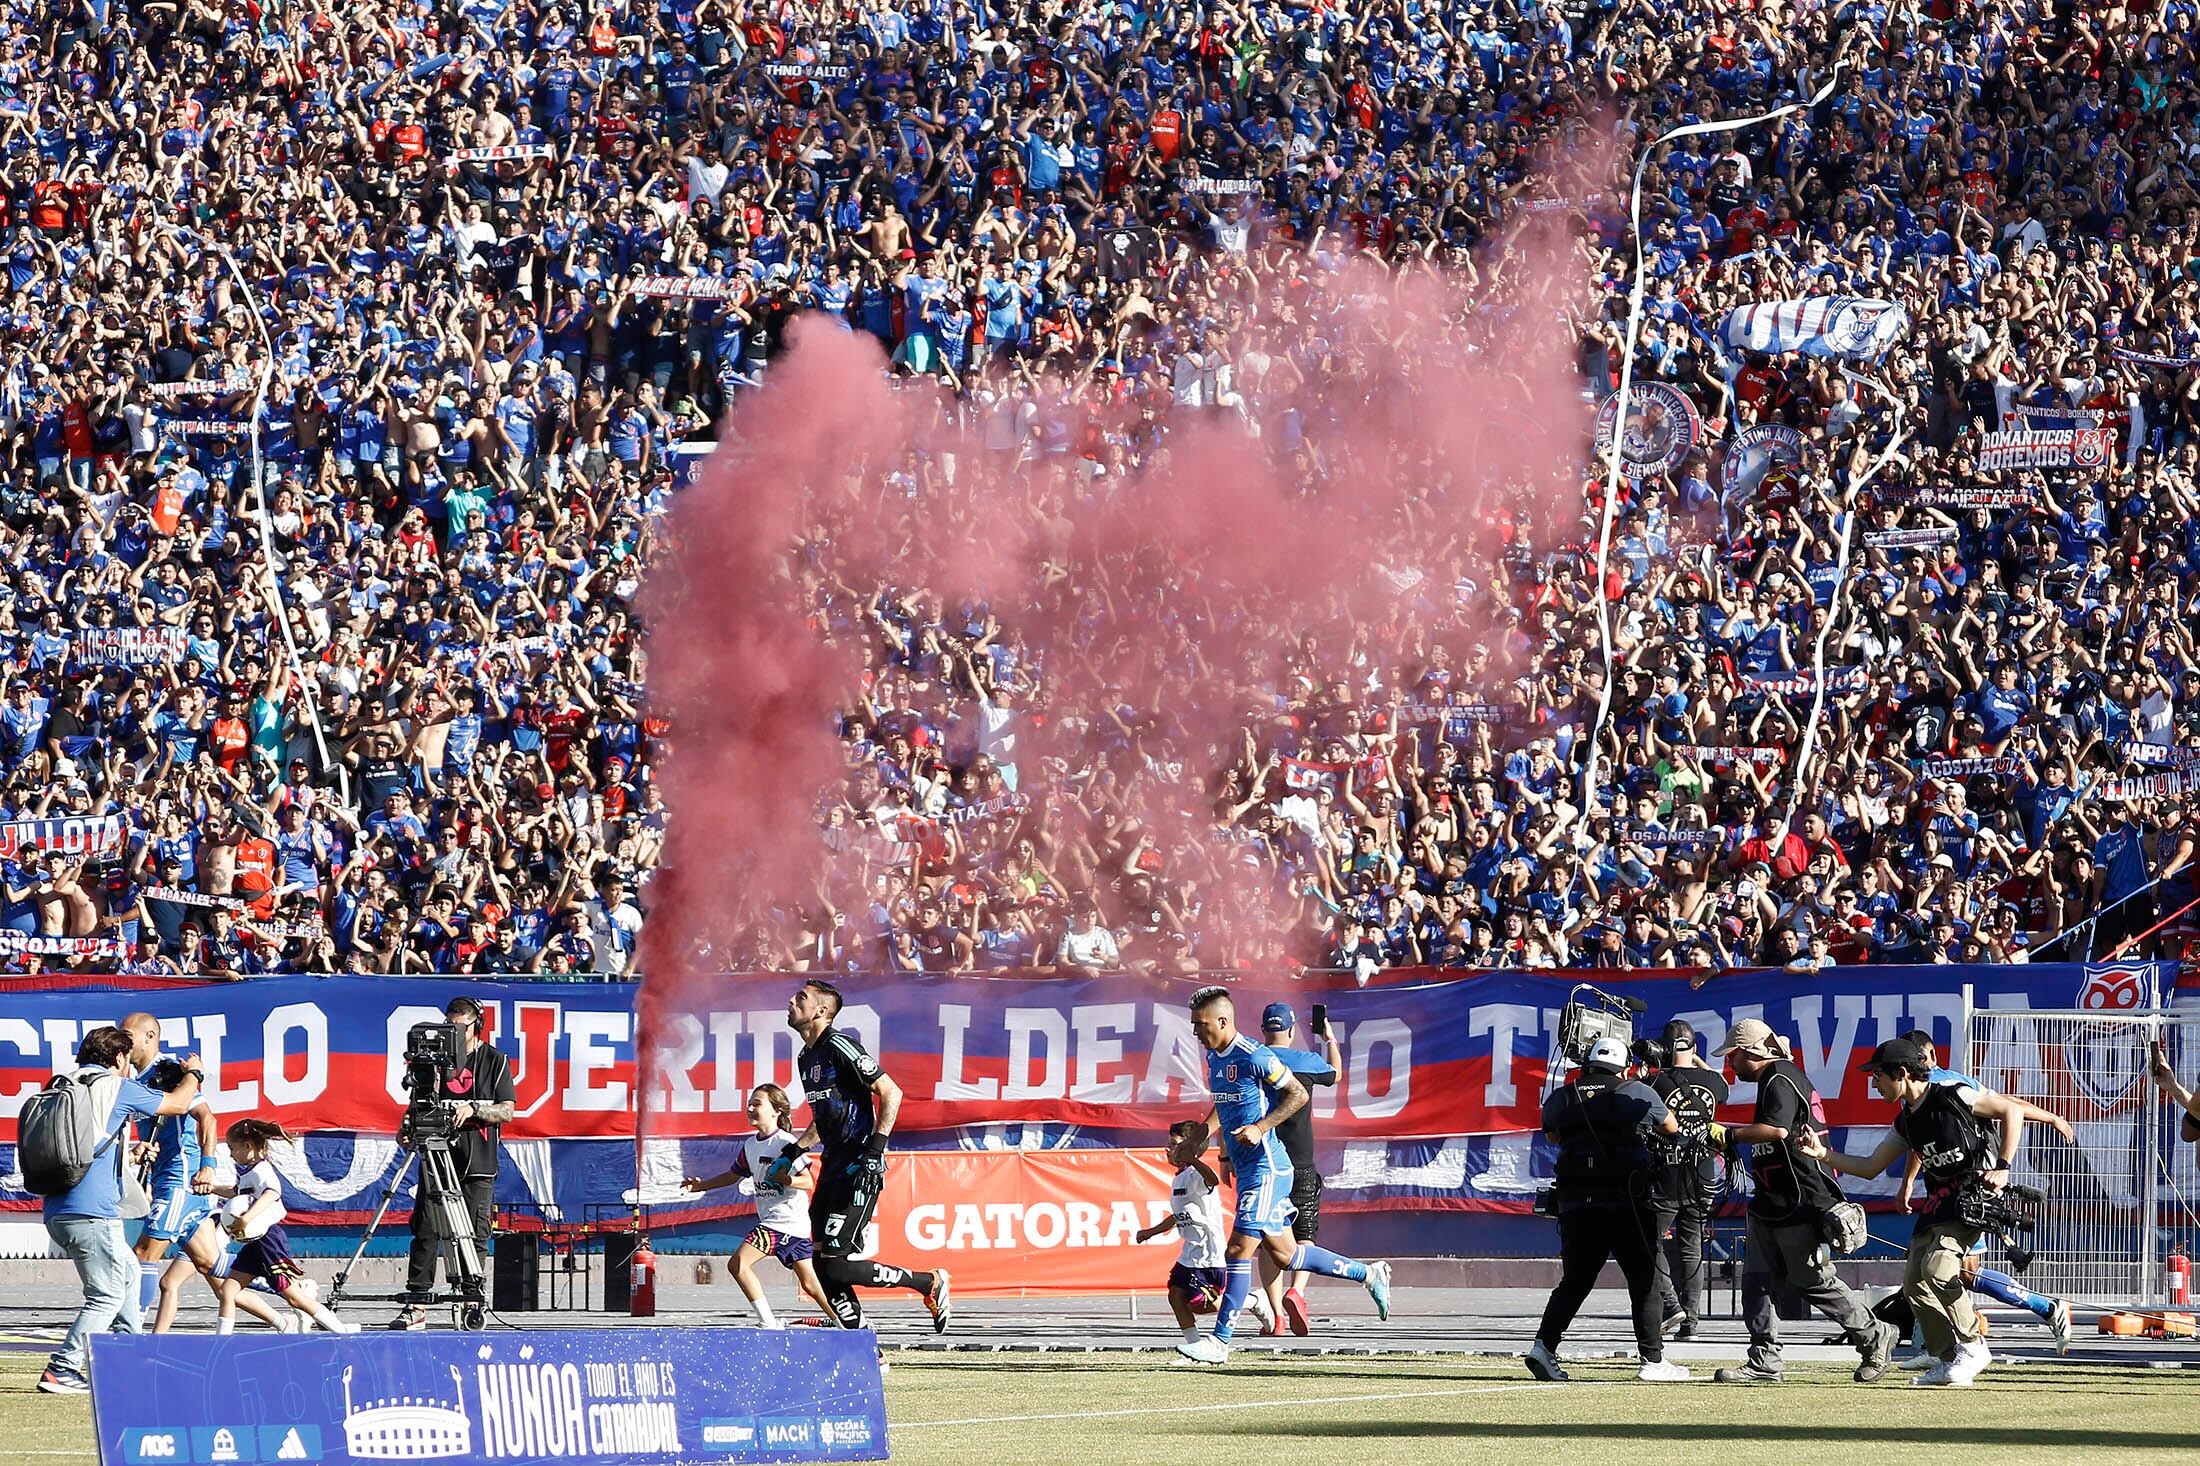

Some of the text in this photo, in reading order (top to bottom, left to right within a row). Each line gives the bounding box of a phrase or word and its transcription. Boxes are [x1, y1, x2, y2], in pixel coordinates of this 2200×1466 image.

[767, 64, 848, 78] THNO ALTO
[629, 276, 720, 299] BAJOS DE MENA
[2016, 404, 2060, 418] ROMANTICOS
[168, 420, 227, 434] RITUALES
[1981, 429, 2073, 450] ROMANTICOS
[1979, 446, 2071, 471] BOHEMIOS
[81, 629, 103, 664] LOS
[490, 636, 546, 655] SIEPRE
[2119, 771, 2181, 799] JOAQUIN
[1658, 830, 1704, 841] ANDES
[1922, 1147, 1965, 1173] PORTS
[905, 1202, 1186, 1252] GATORAD
[584, 1355, 677, 1399] TODO EL AÑO ES
[765, 1423, 809, 1444] MACH
[834, 1419, 858, 1432] OCEAN
